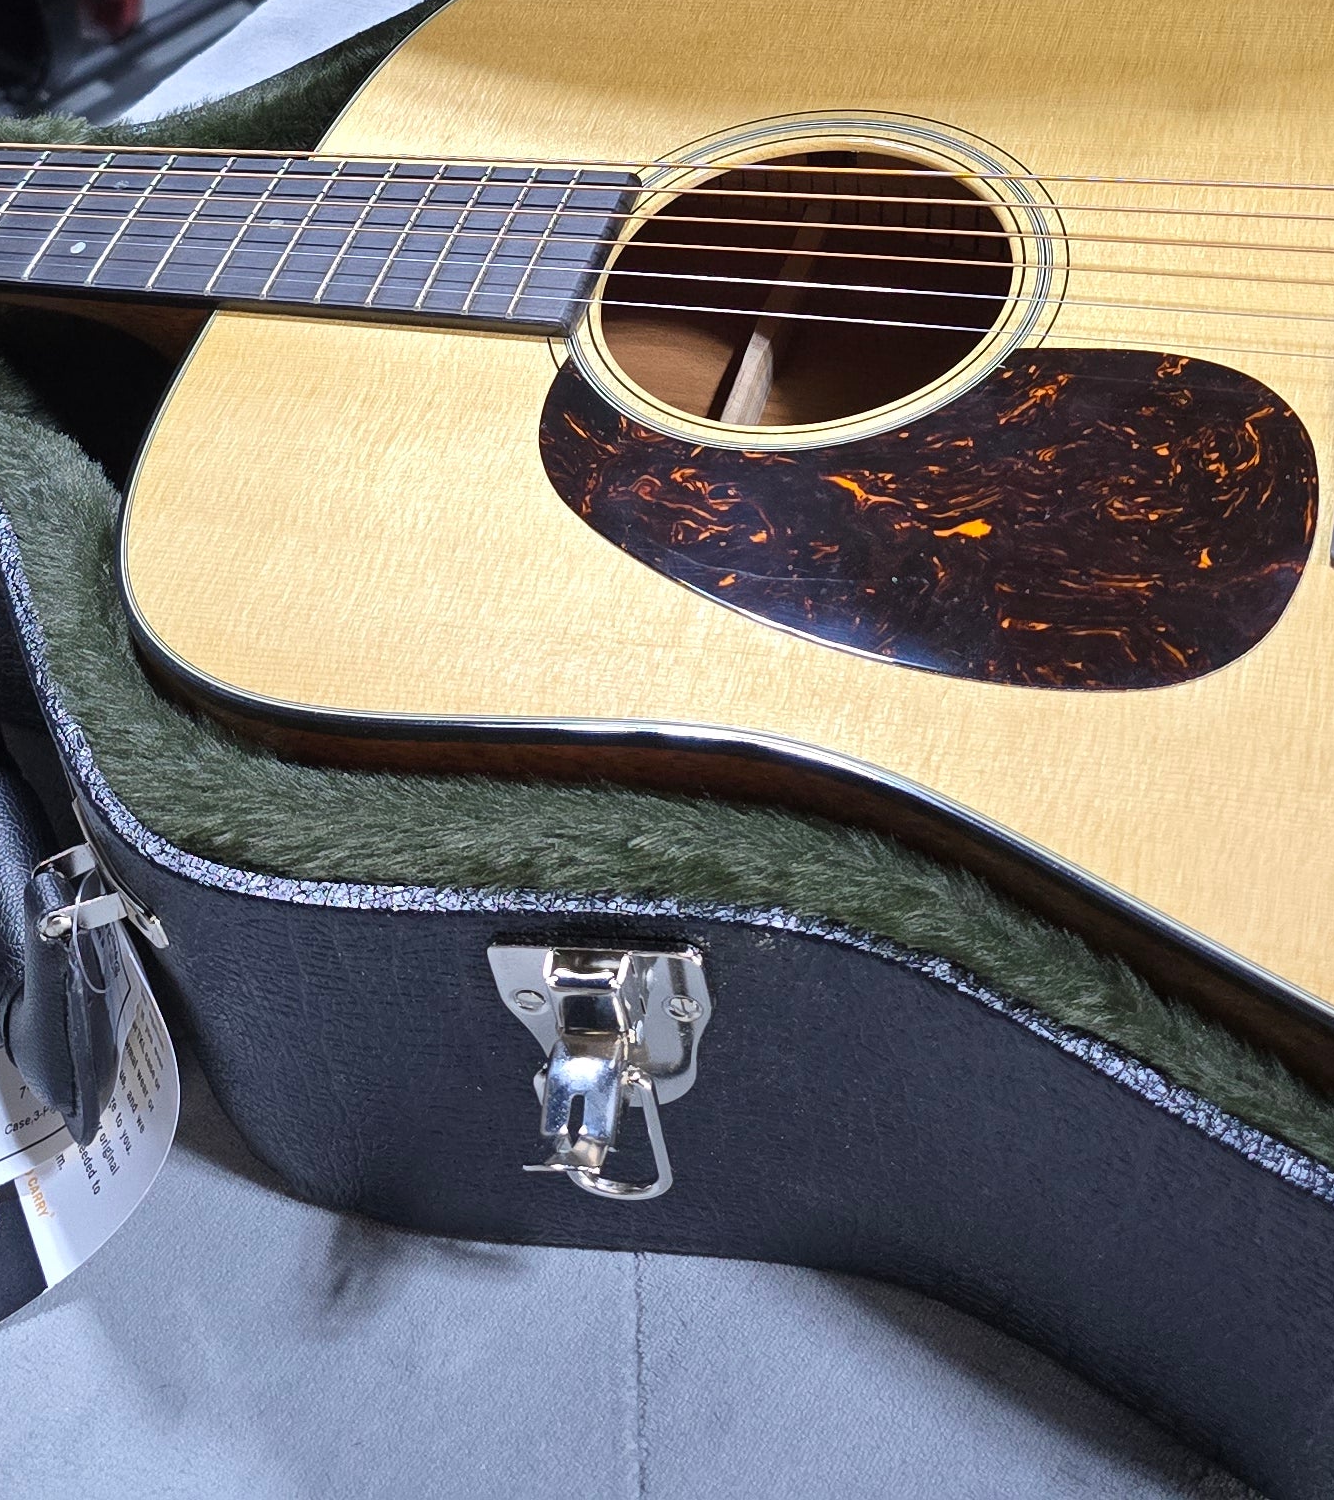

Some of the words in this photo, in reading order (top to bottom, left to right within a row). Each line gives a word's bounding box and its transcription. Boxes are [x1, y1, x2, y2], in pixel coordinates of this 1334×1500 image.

[115, 1112, 123, 1128] to
[119, 1128, 132, 1156] you.
[126, 1090, 139, 1115] and
[136, 1114, 145, 1134] we
[99, 1132, 120, 1177] original
[28, 1177, 49, 1217] CARRY
[92, 1179, 101, 1195] to
